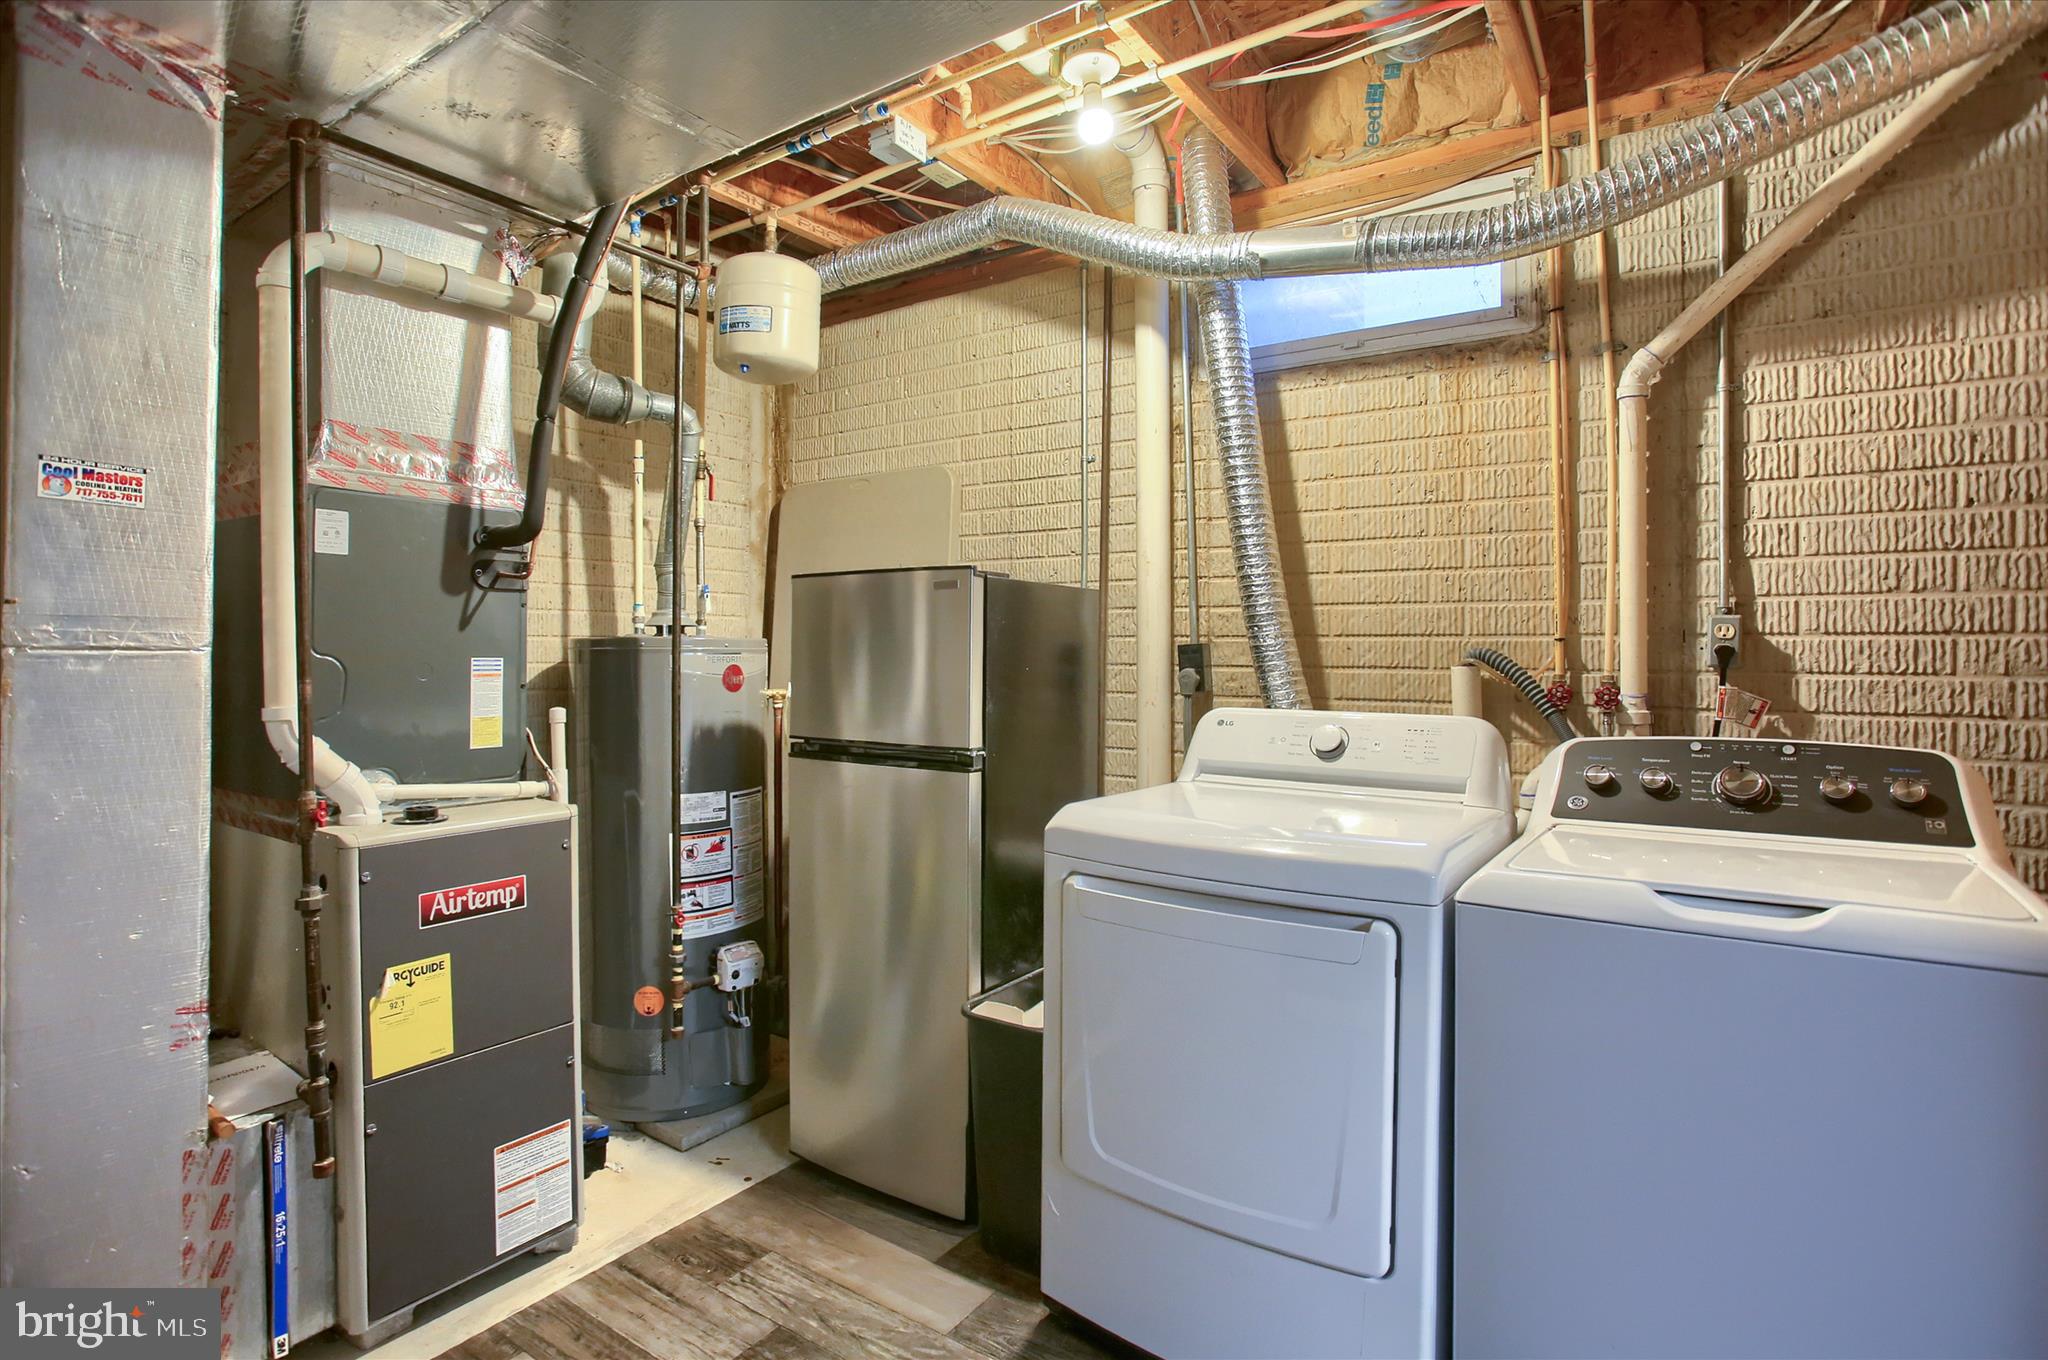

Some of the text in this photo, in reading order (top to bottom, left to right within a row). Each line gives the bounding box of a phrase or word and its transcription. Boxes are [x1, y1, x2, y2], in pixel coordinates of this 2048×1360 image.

[729, 321, 751, 329] WATTS
[42, 462, 143, 487] Cool Masters
[75, 480, 107, 490] COOLING
[114, 484, 143, 494] HEATING
[75, 487, 143, 503] 717-755-7611
[429, 886, 518, 921] Airtemp
[393, 960, 446, 985] RGYGUIDE
